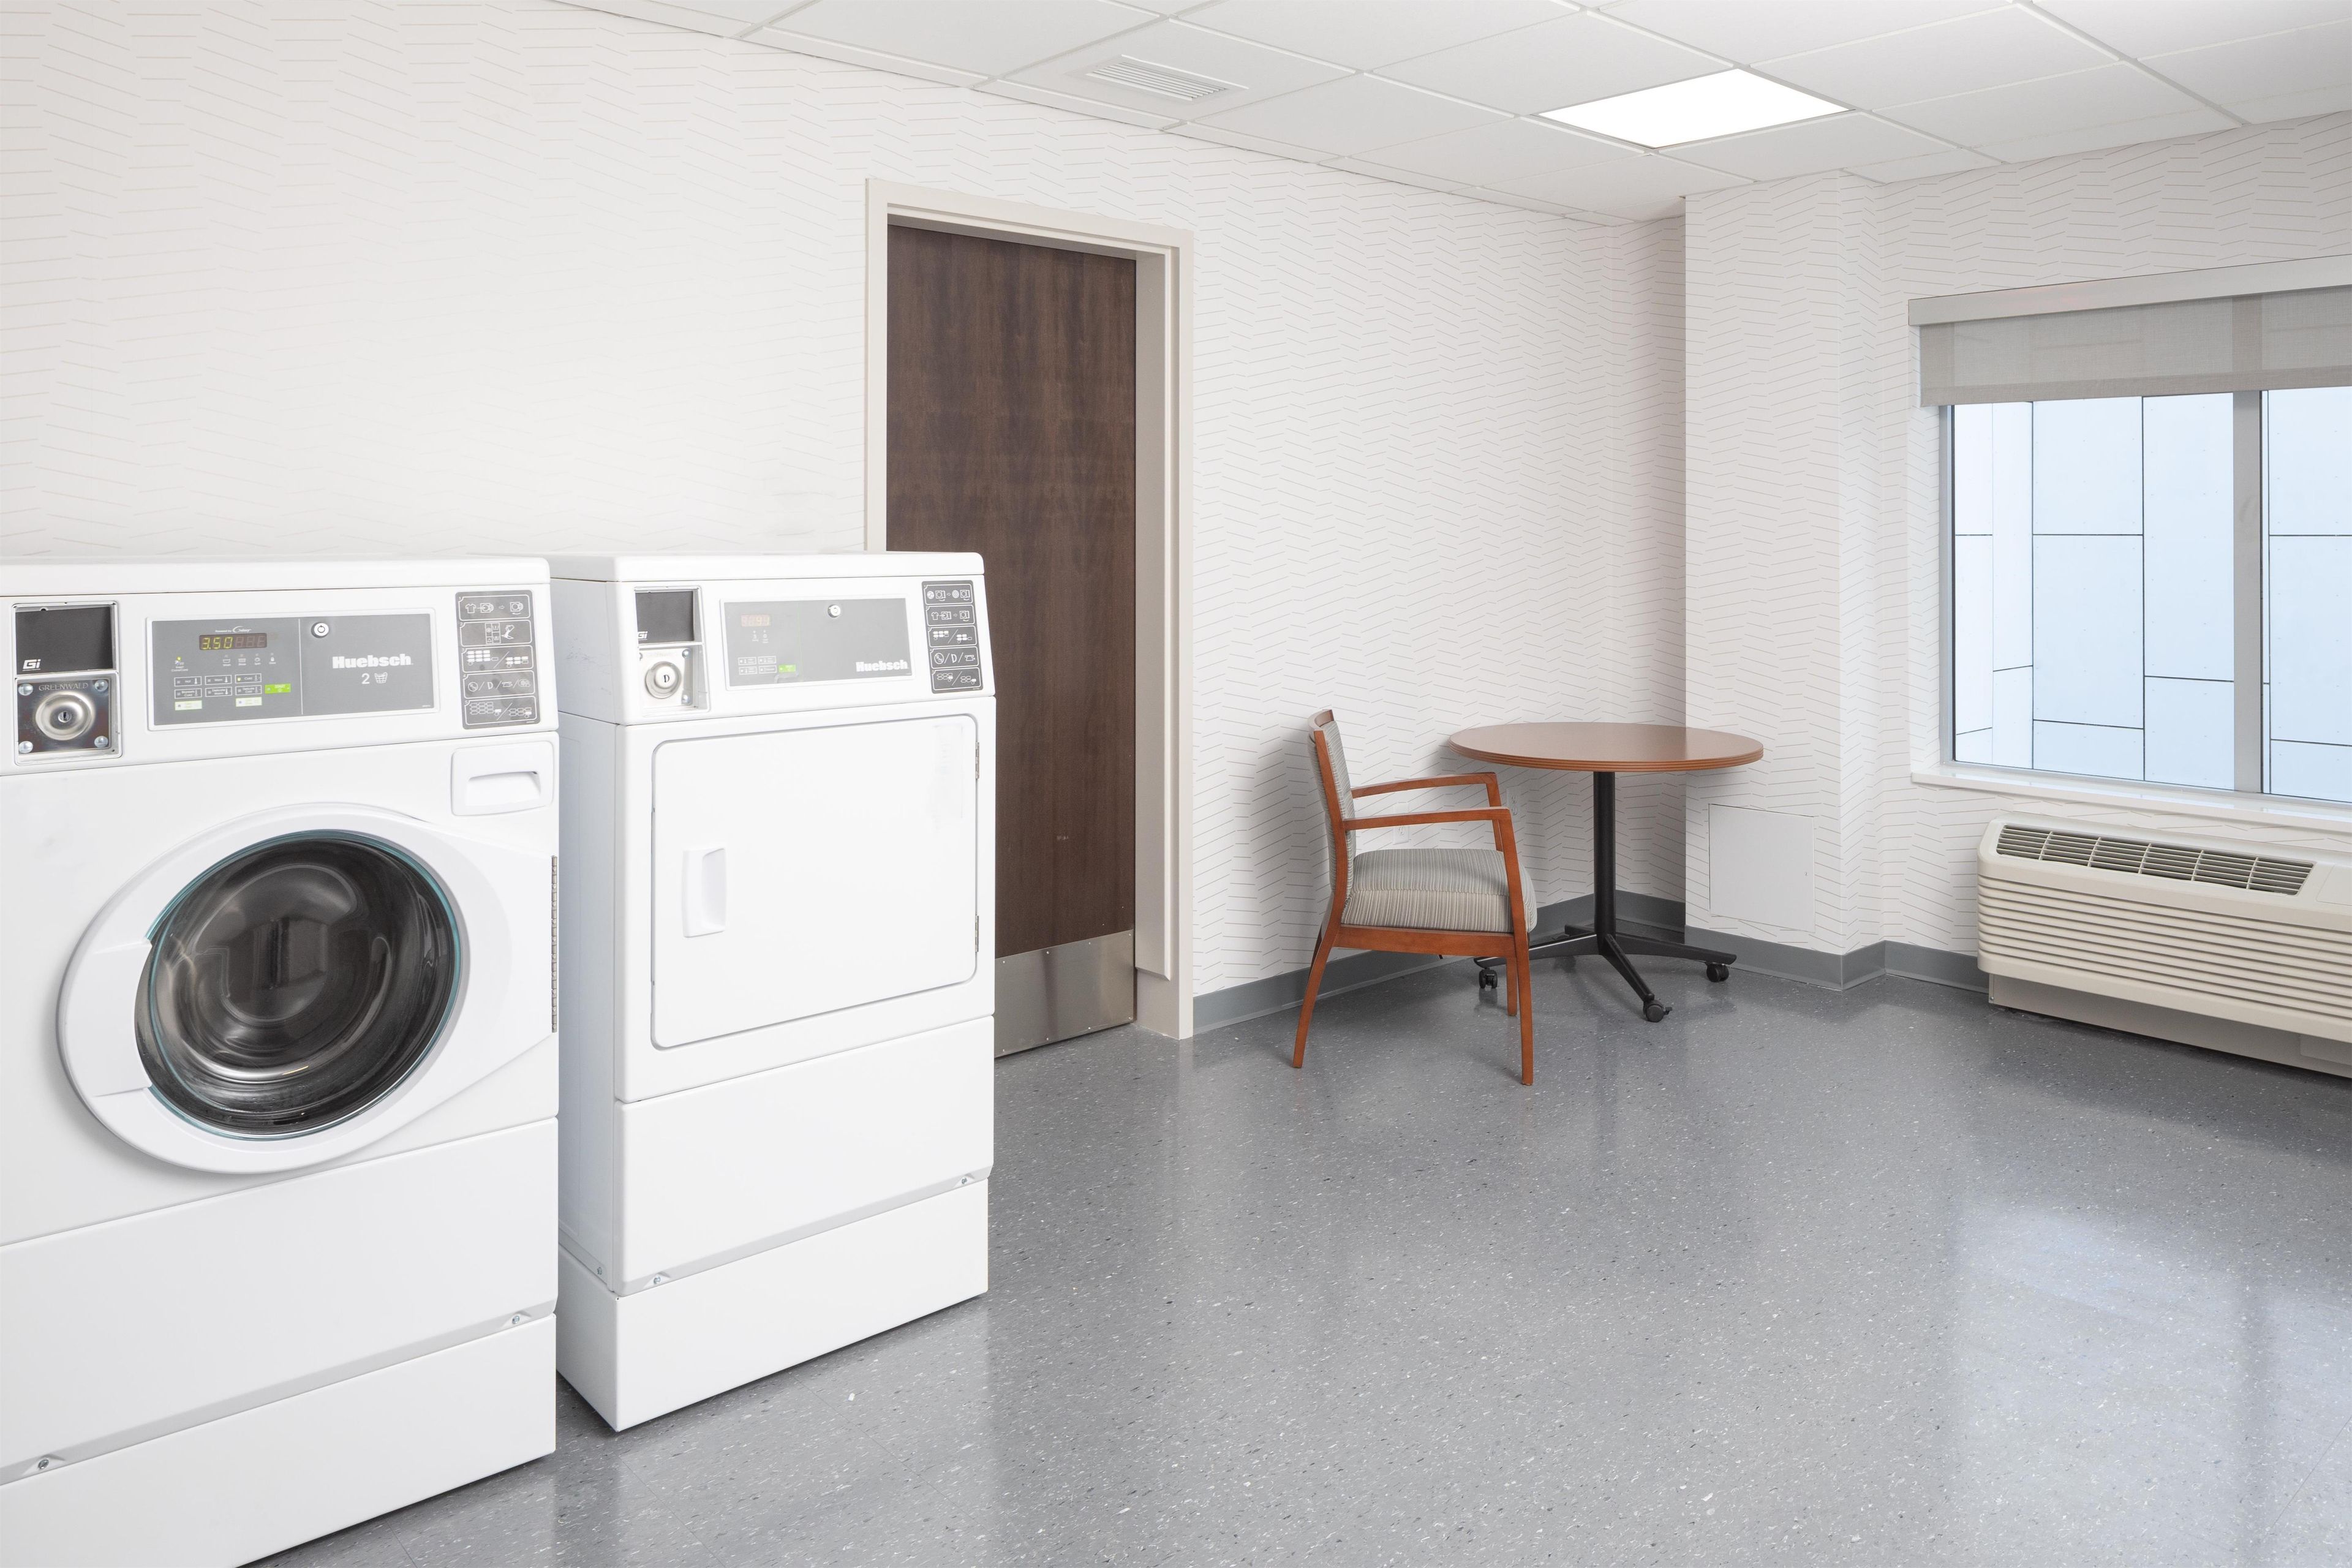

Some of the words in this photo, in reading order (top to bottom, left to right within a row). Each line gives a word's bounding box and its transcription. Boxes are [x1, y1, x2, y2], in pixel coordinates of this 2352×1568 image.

[23, 658, 42, 669] Gi
[332, 654, 412, 669] Huebsch
[855, 659, 908, 672] Huebsch
[361, 673, 370, 684] 2
[39, 682, 88, 692] GREENWALD
